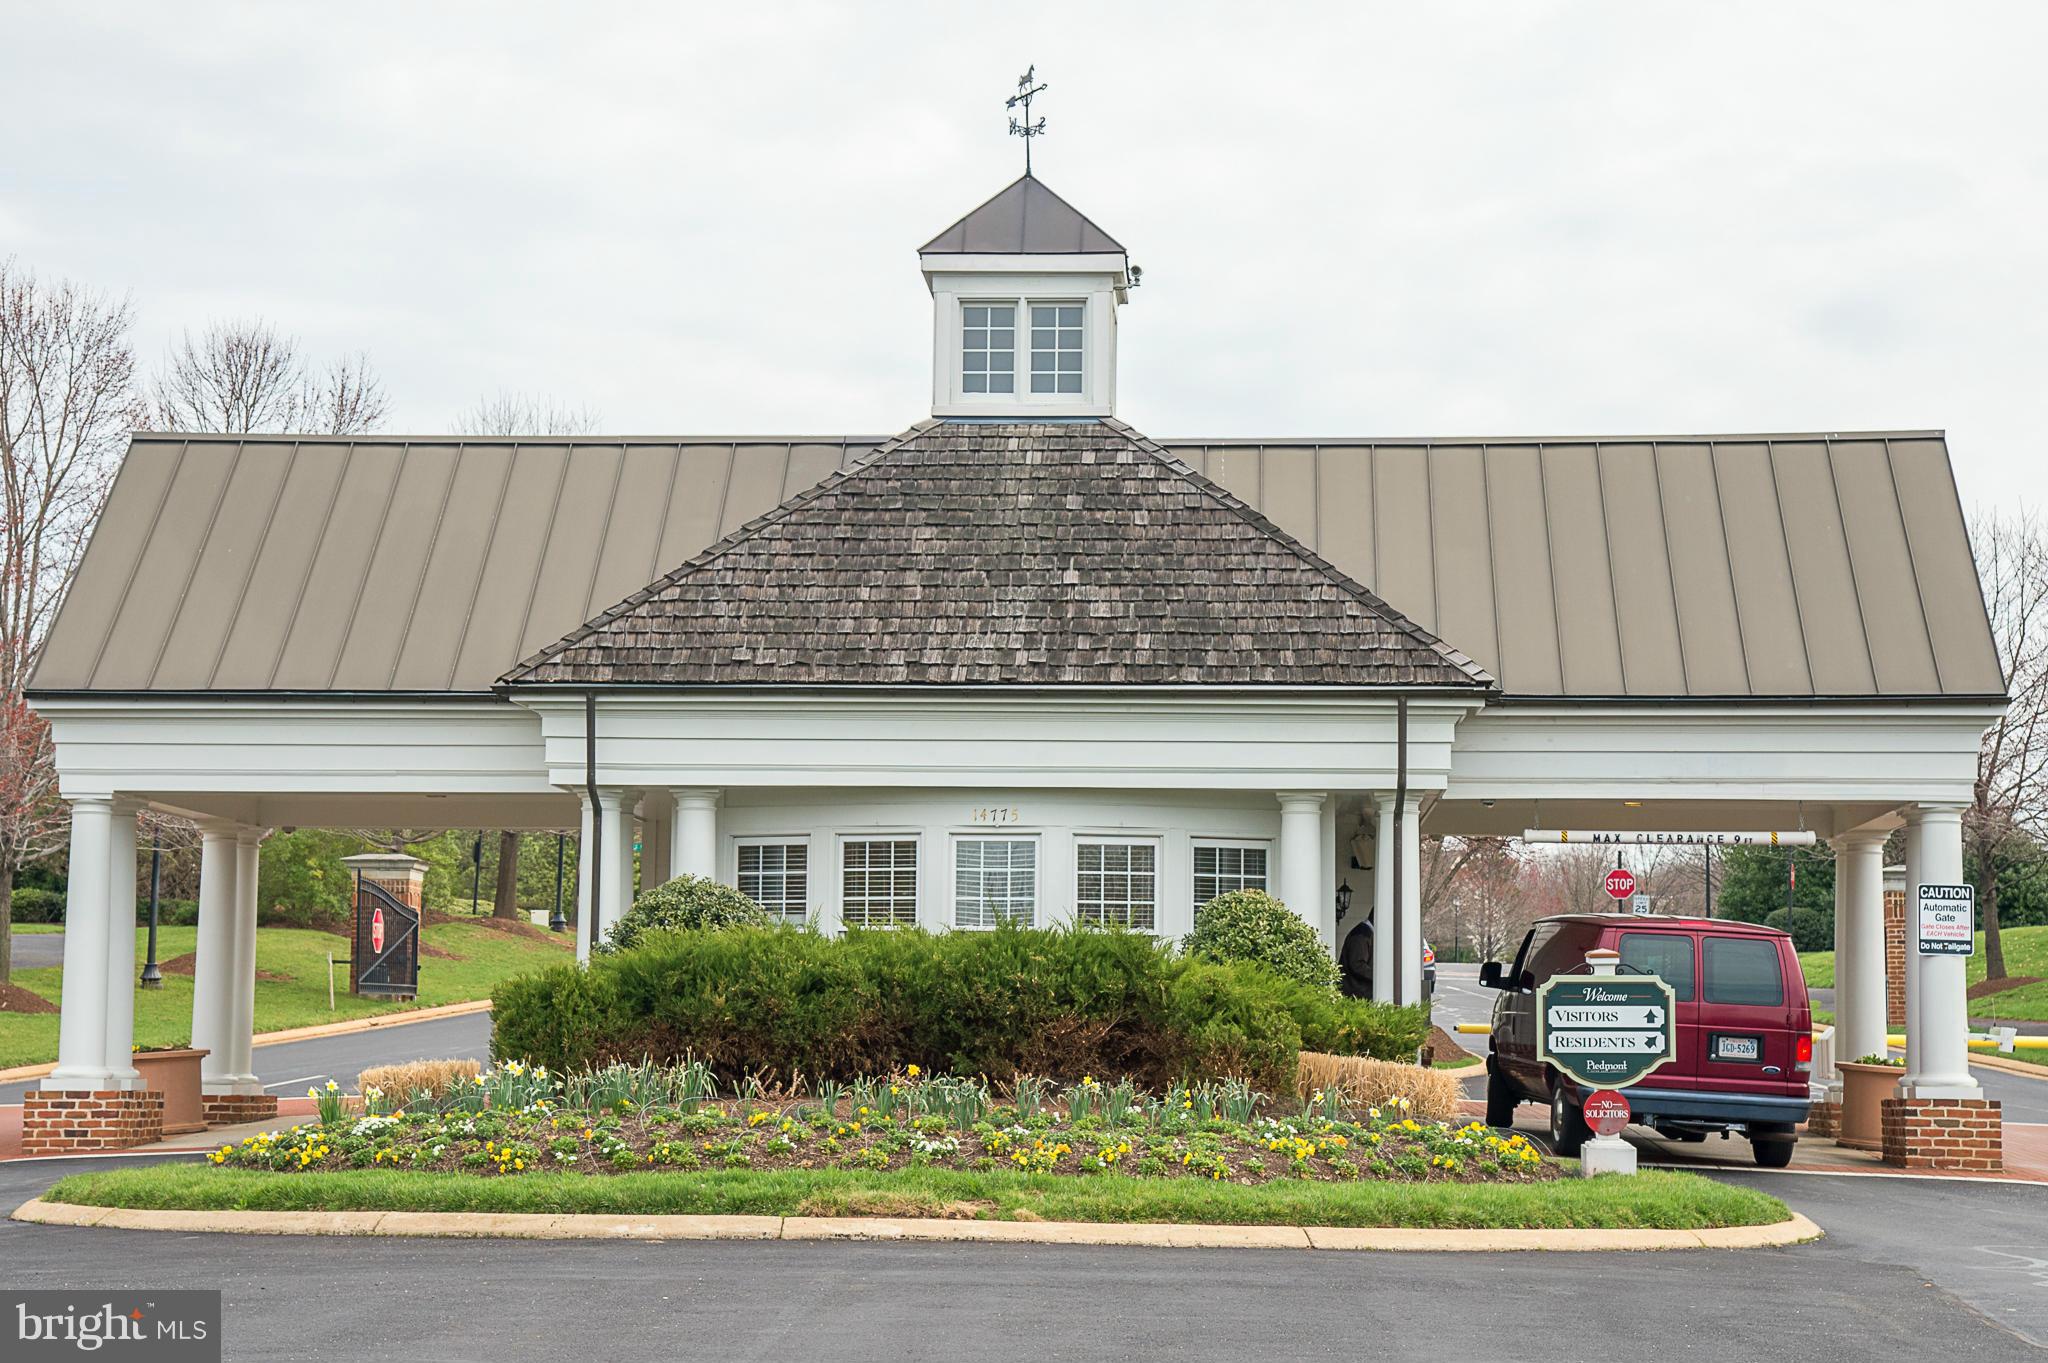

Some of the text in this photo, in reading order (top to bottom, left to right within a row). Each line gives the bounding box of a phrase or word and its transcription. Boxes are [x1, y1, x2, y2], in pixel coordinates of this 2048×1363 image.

[972, 808, 1019, 822] 14775
[1592, 833, 1621, 844] MAX
[1636, 833, 1724, 845] CLEARANCE
[1734, 834, 1741, 844] 9
[1607, 878, 1634, 890] STOP
[1920, 887, 1970, 899] CAUTION
[1635, 905, 1648, 913] 25
[1923, 902, 1968, 912] Automatic
[1934, 912, 1956, 922] Gate
[1926, 930, 1943, 938] EACH
[1920, 942, 1971, 952] Do Not Tailgate
[1582, 987, 1628, 1002] Welcome
[1555, 1010, 1619, 1022] VISITORS
[1555, 1036, 1636, 1048] RESIDENTS
[1586, 1060, 1628, 1072] Piedmont
[1601, 1100, 1613, 1109] NO
[1585, 1109, 1629, 1118] SOLICITORS
